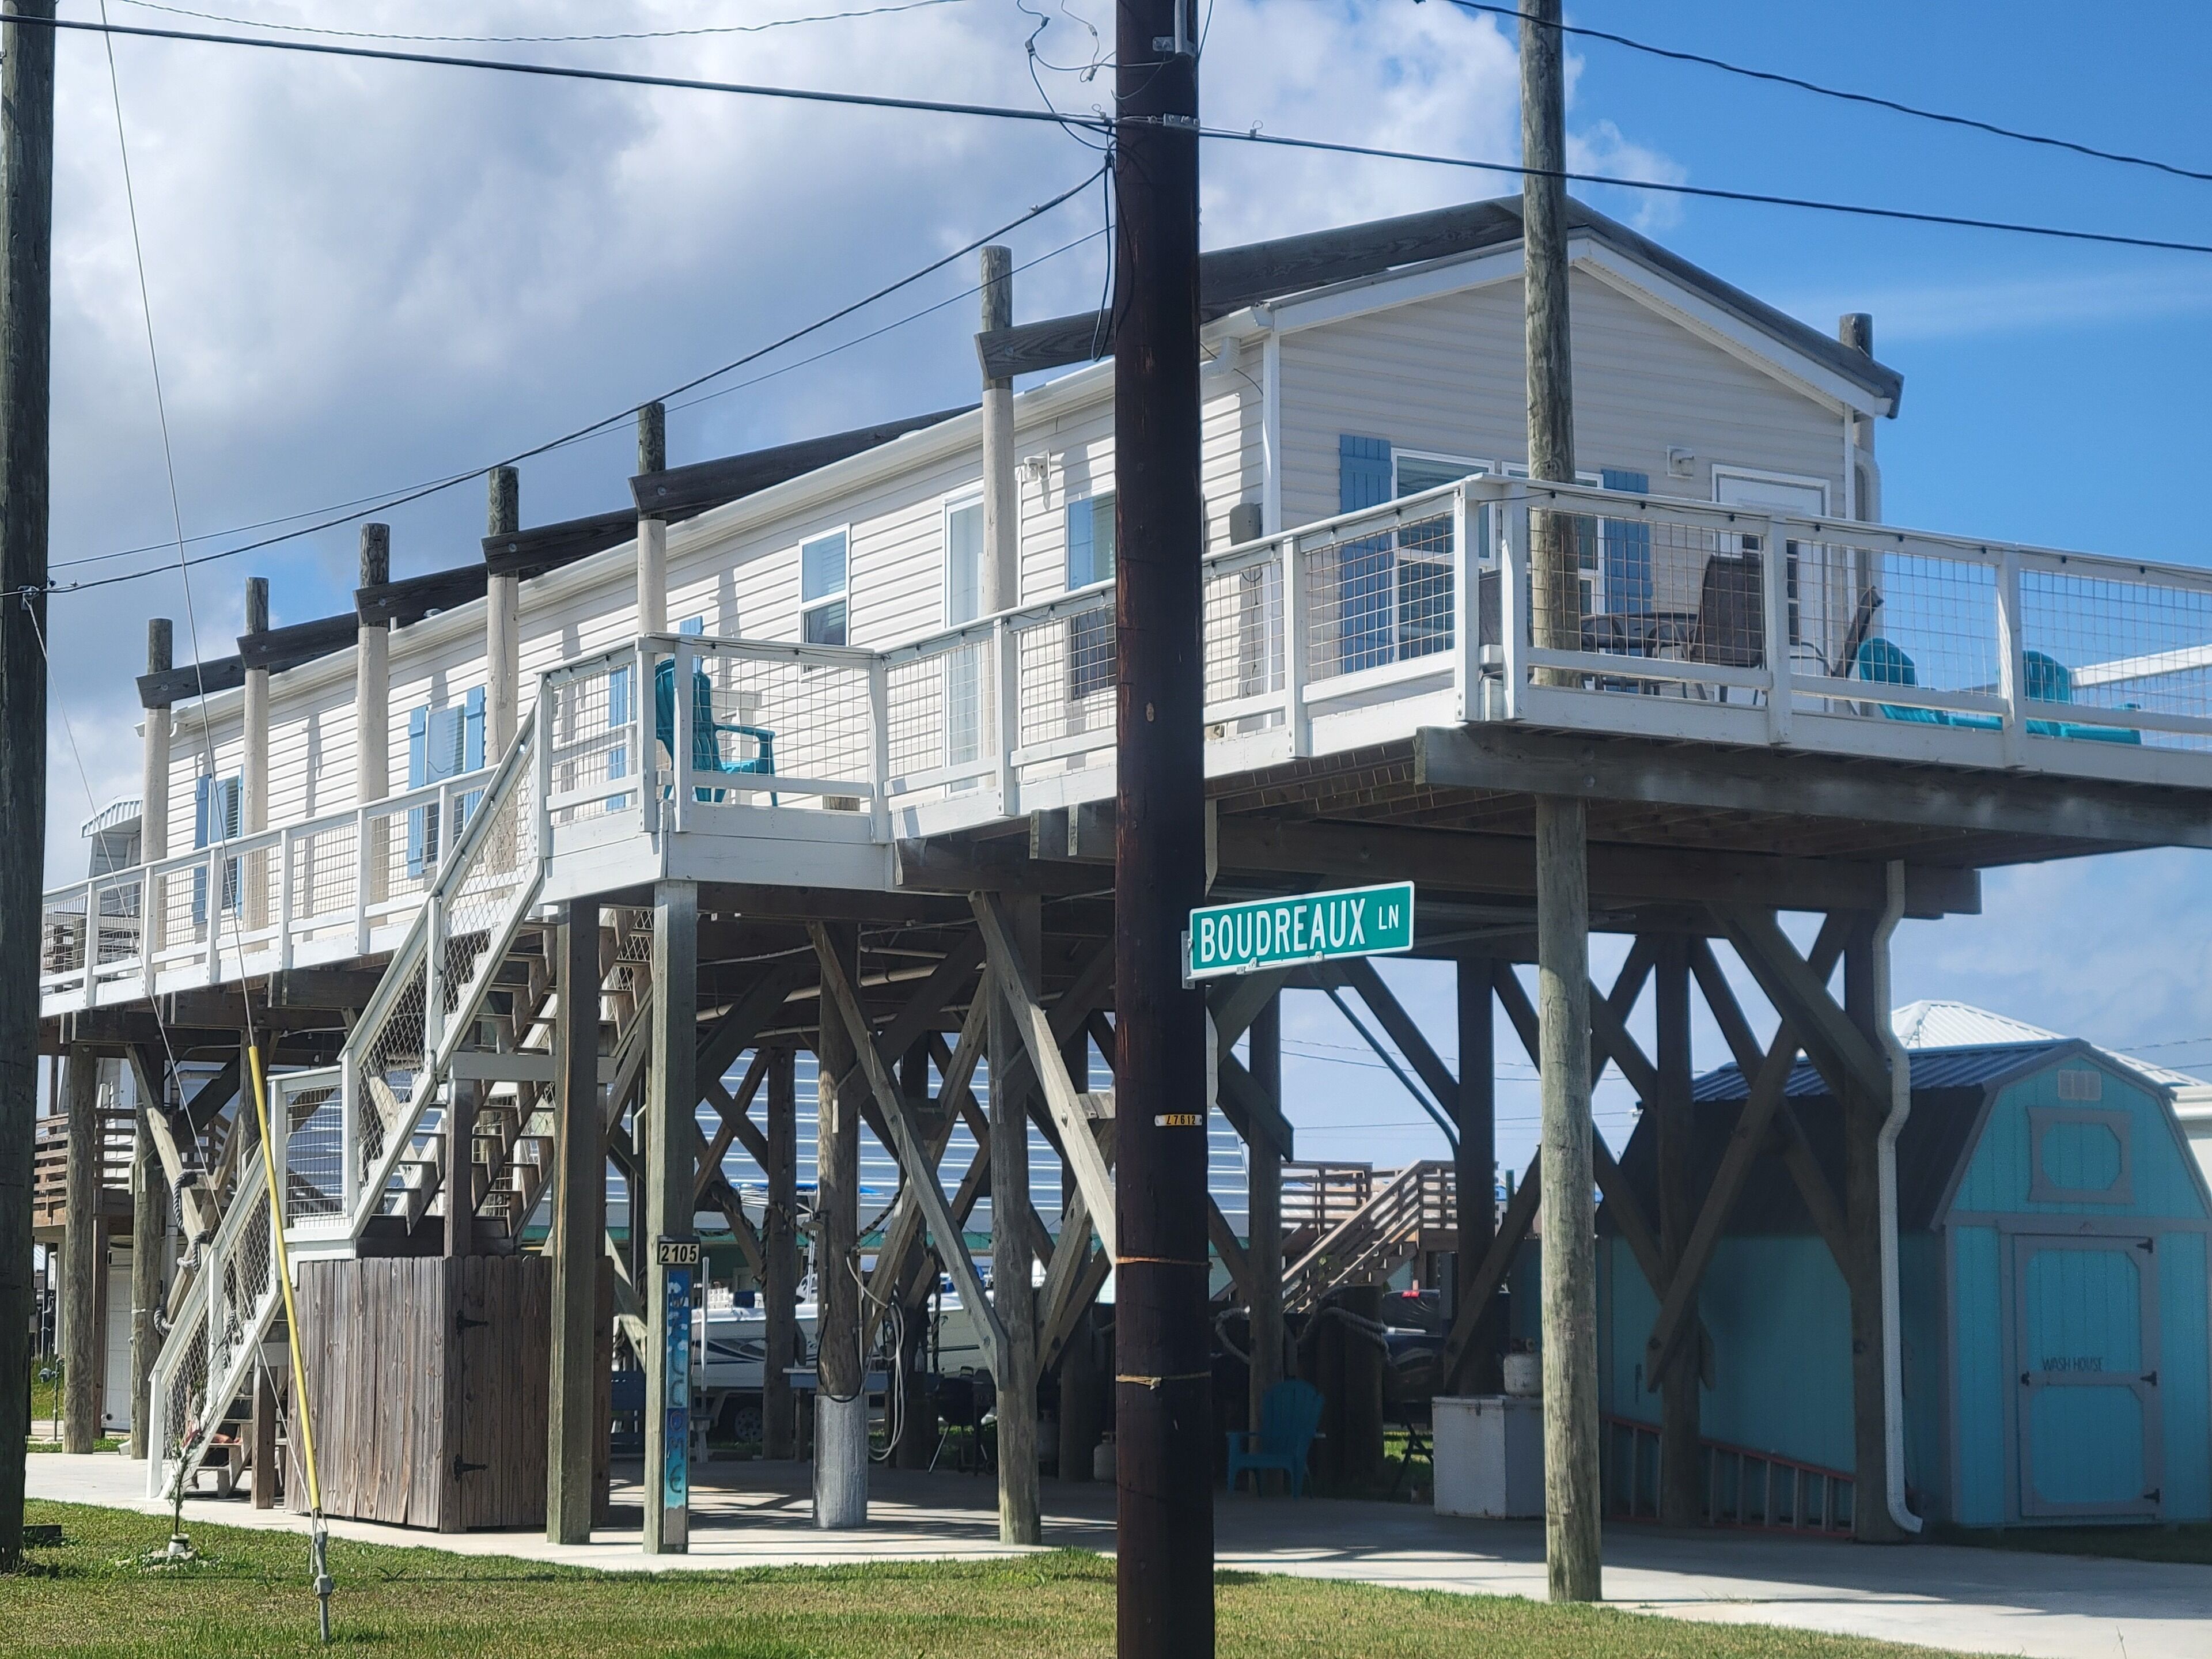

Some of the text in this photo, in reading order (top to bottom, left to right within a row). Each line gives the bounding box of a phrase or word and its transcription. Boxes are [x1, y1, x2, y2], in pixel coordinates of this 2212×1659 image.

[1200, 897, 1399, 963] BOUDREAUX LN
[661, 1245, 696, 1262] 2105
[2043, 1357, 2103, 1372] WASH HOUSE
